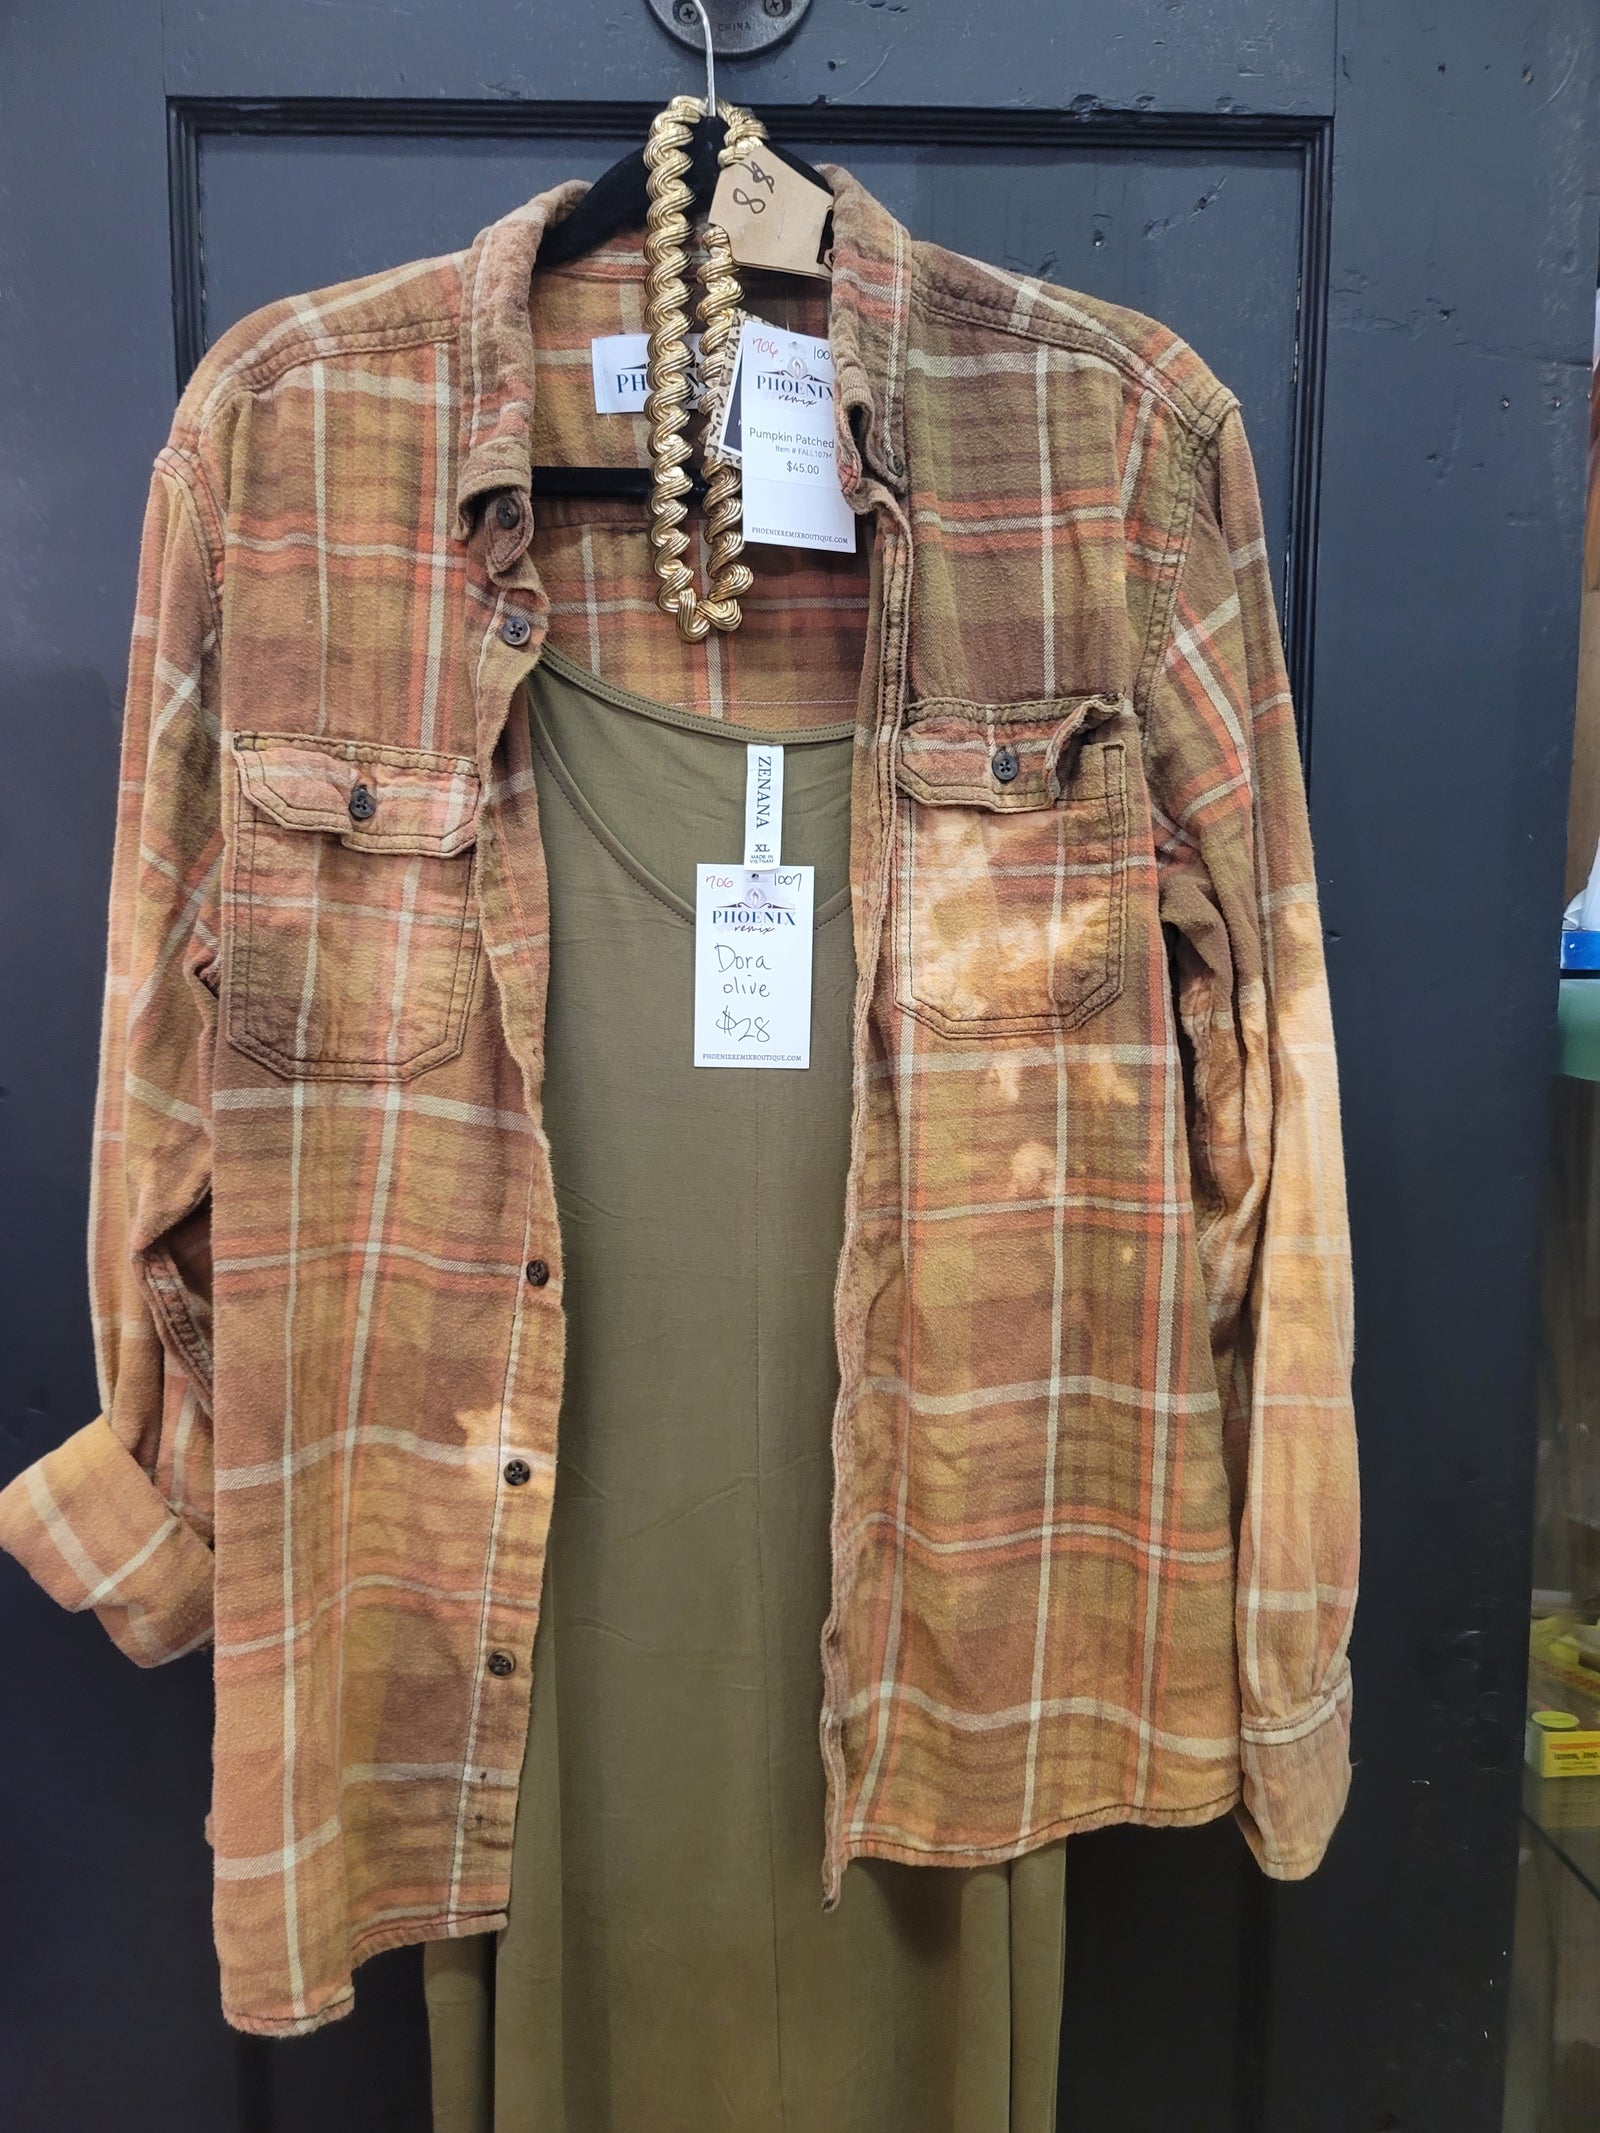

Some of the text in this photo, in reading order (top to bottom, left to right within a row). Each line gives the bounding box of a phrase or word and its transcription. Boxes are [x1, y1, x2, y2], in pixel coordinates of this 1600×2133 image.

[718, 21, 751, 32] CHINA
[752, 337, 779, 359] 706
[813, 345, 832, 361] 100
[778, 394, 817, 408] remix
[749, 427, 835, 449] Pumpkin Patched
[775, 445, 790, 454] Item
[786, 460, 820, 475] $45.00
[751, 526, 849, 545] PHOENIXREMIXBOUTIQUE.COM
[756, 756, 771, 829] ZENANA
[754, 844, 770, 852] XL
[705, 875, 734, 889] 706
[712, 910, 796, 926] PHOENIX
[734, 924, 776, 935] remix
[714, 942, 772, 973] Dora
[723, 974, 771, 998] olive
[715, 1005, 771, 1043] $28
[702, 1053, 802, 1062] PHOENIXREMIXBOUTIQUE.COM
